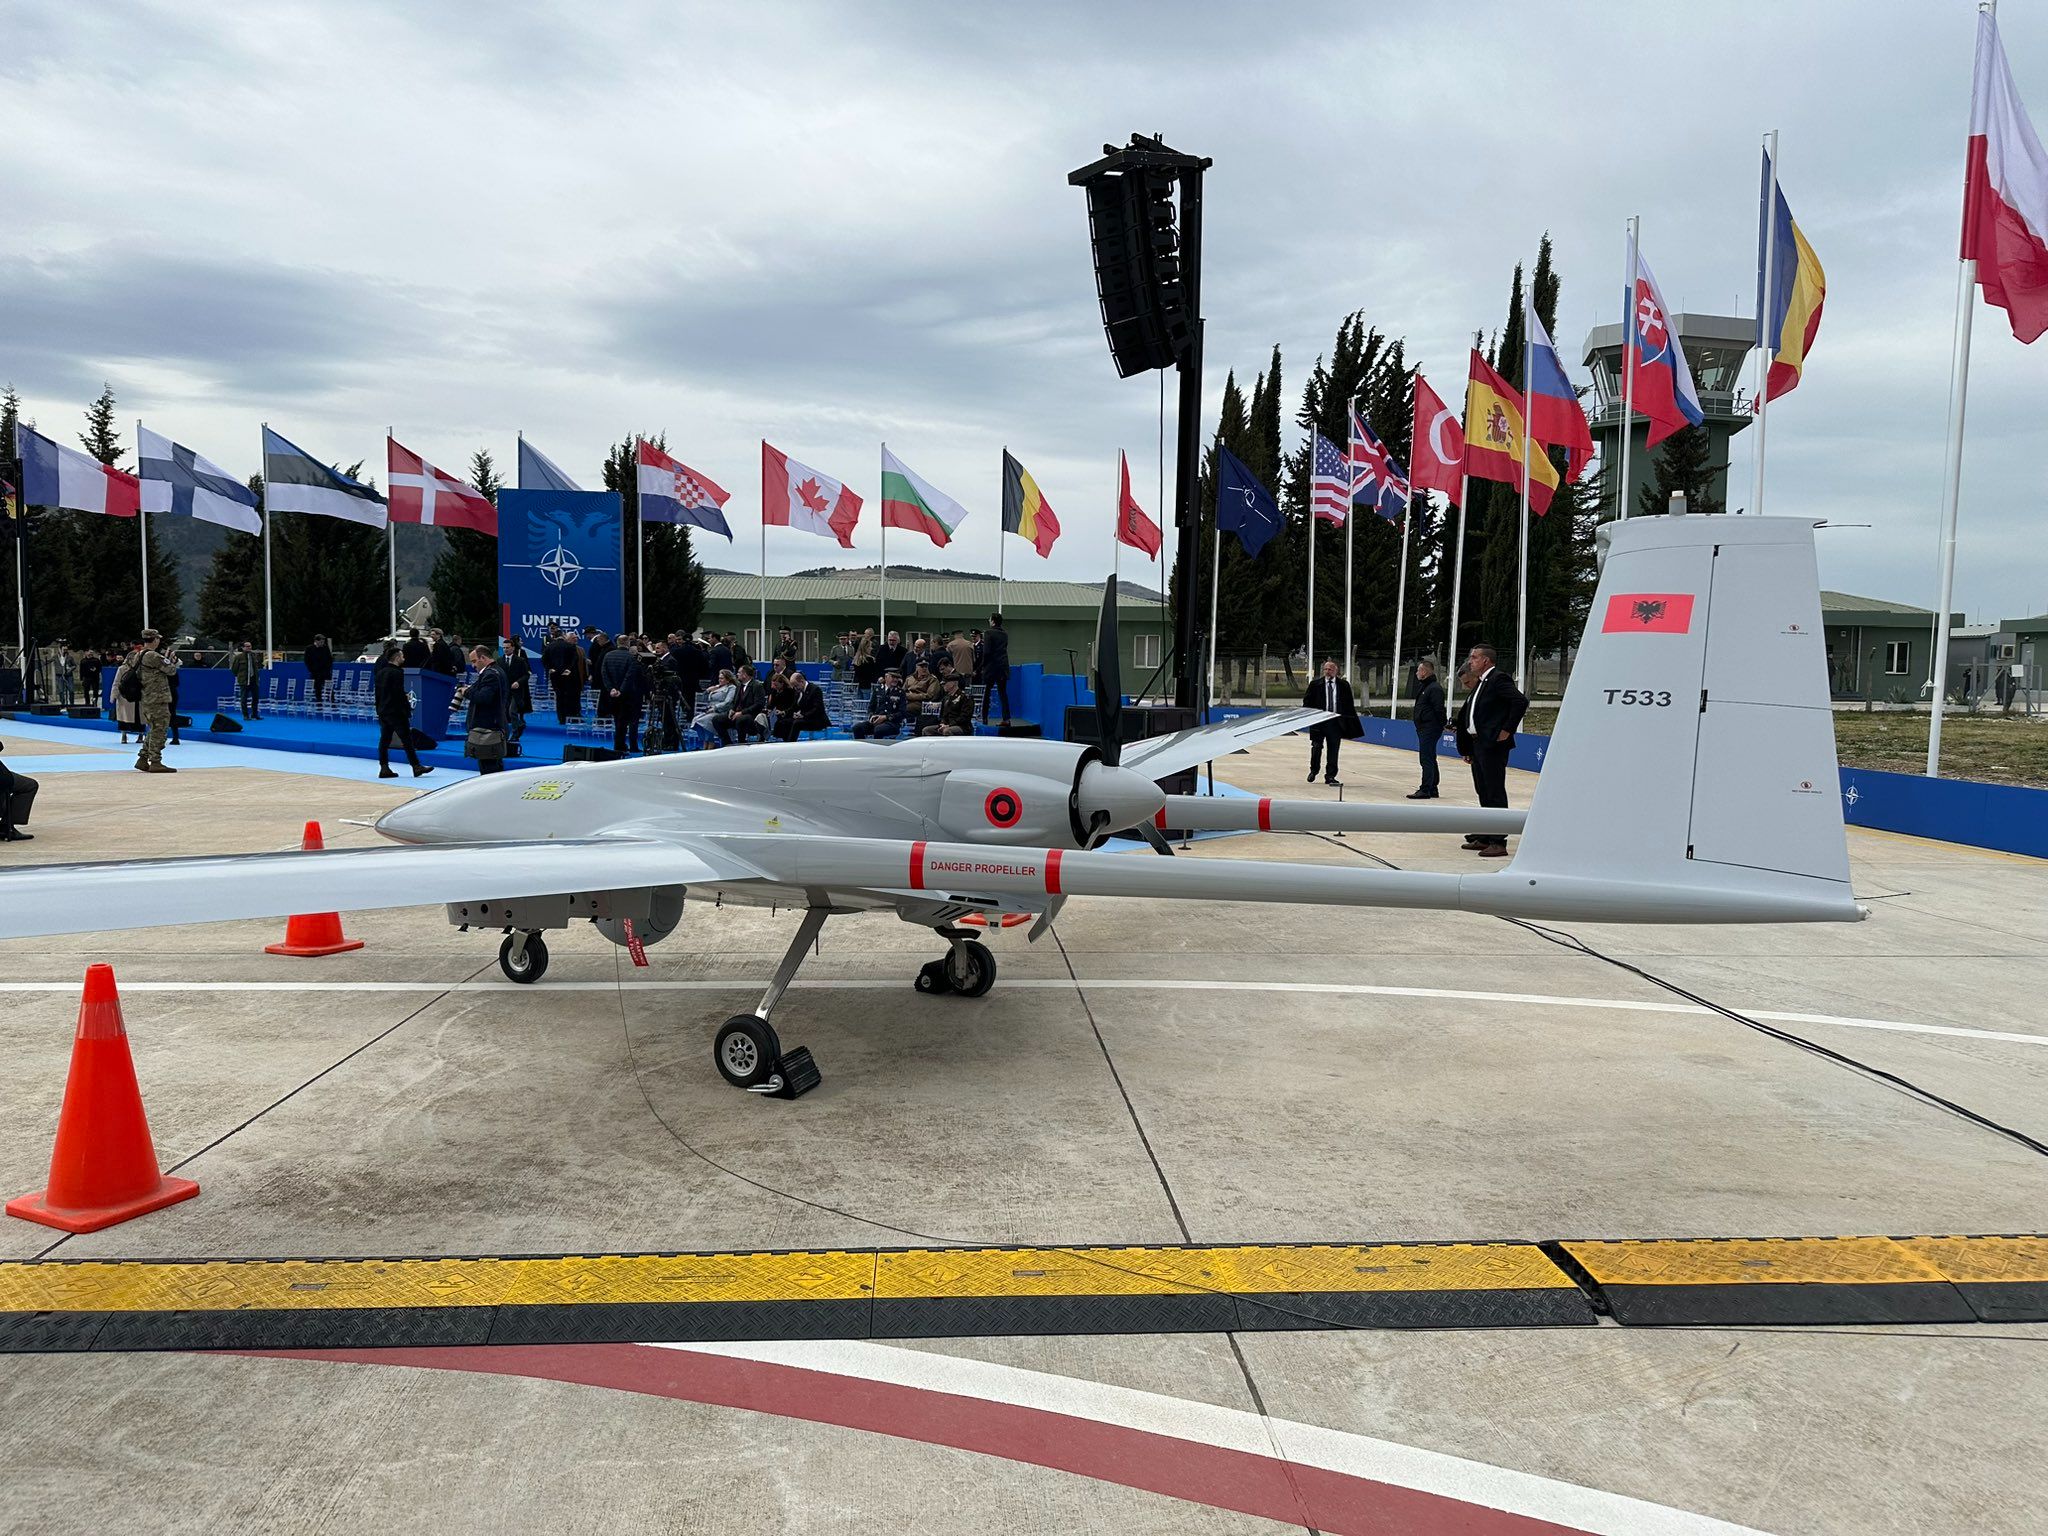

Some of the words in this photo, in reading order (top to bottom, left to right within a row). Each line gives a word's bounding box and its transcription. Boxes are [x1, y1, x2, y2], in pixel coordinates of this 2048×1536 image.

[522, 614, 581, 627] UNITED
[1603, 689, 1672, 707] T533
[930, 861, 973, 873] DANGER
[974, 863, 1036, 876] PROPELLER
